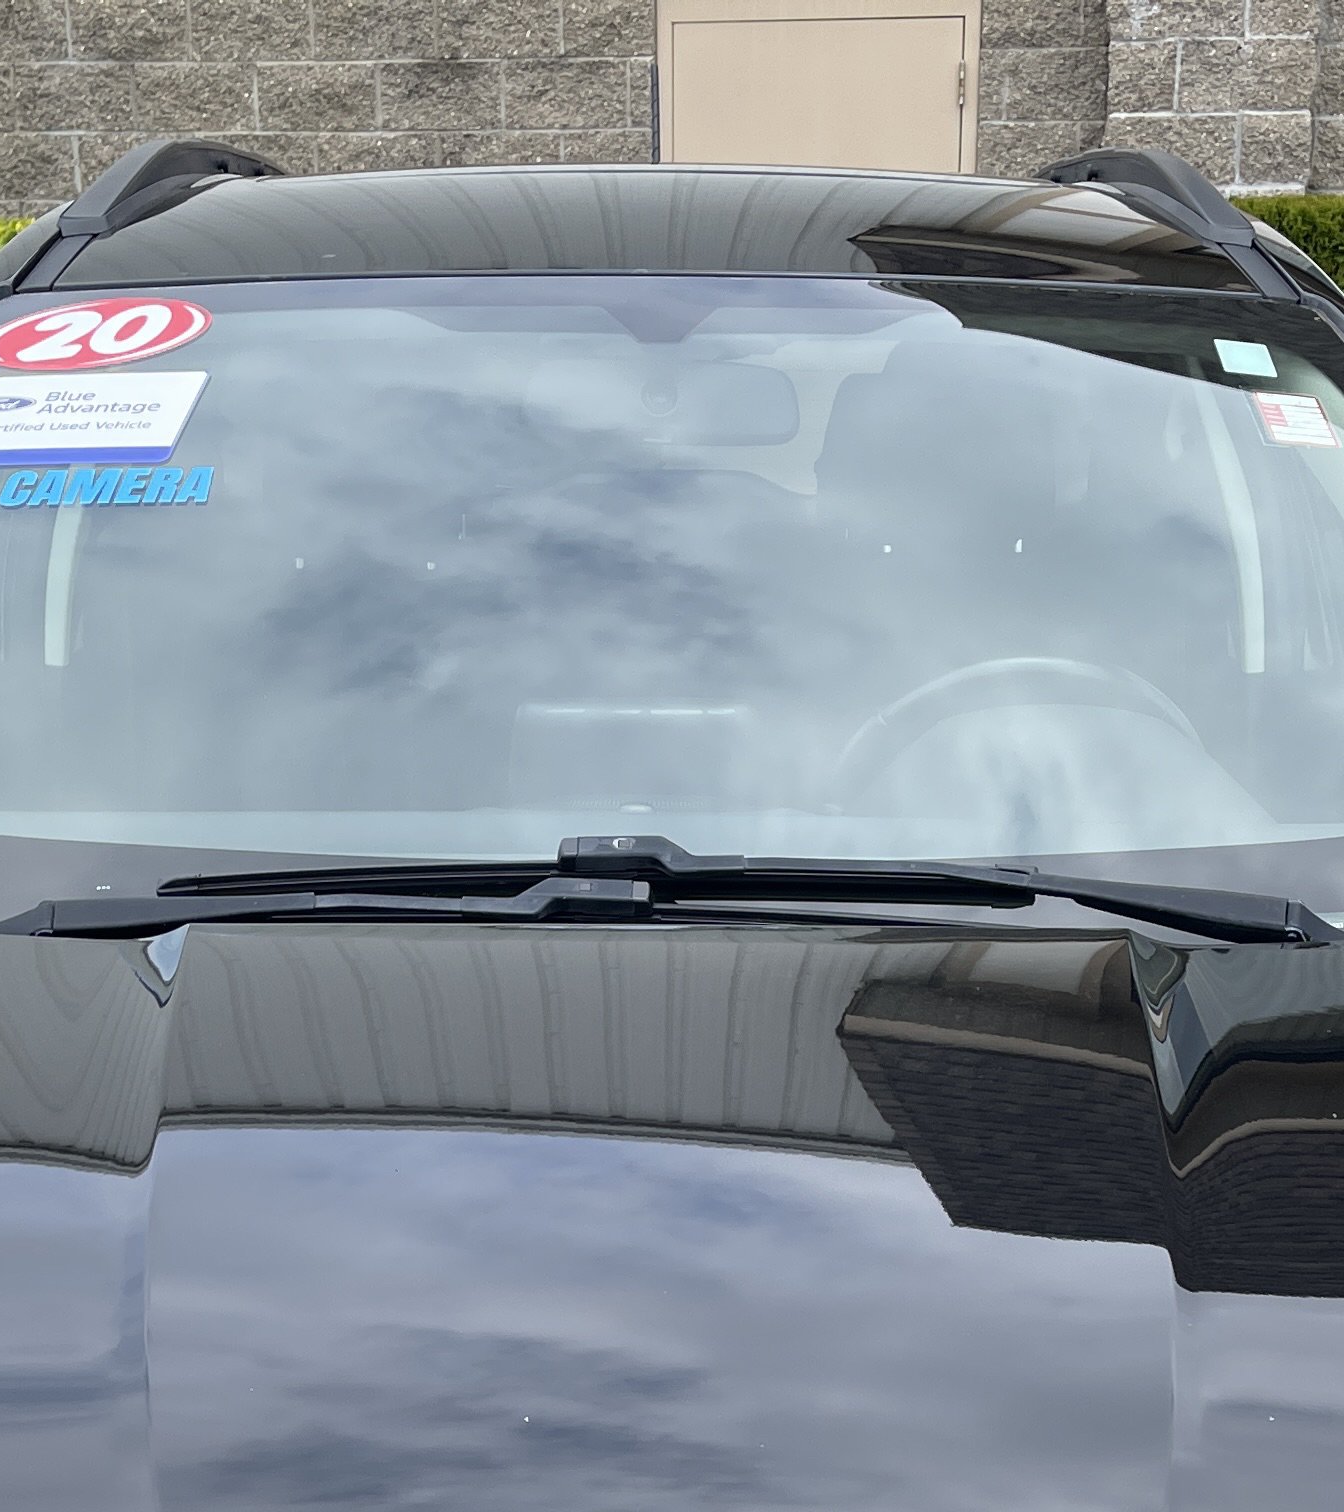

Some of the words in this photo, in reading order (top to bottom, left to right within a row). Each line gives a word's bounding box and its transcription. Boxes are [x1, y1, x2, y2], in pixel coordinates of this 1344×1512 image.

[16, 303, 173, 363] 20
[44, 391, 97, 402] Blue
[36, 401, 162, 415] Advantage
[49, 420, 90, 431] Used
[96, 420, 153, 431] Vehicle
